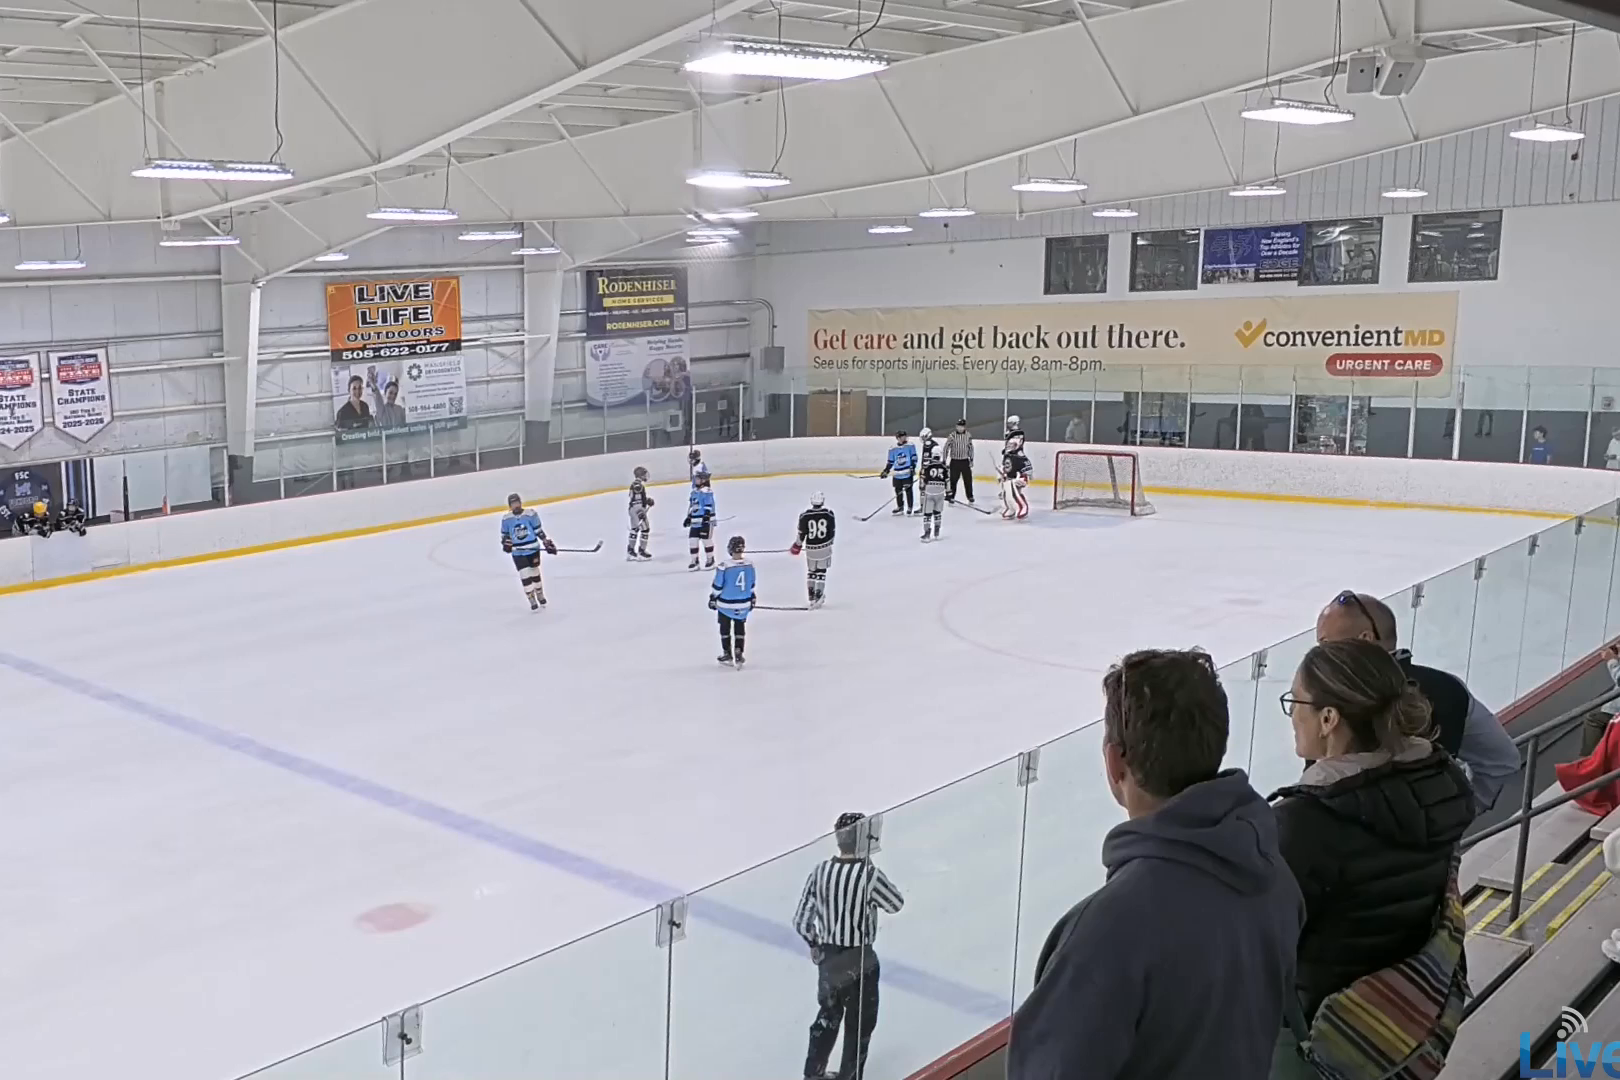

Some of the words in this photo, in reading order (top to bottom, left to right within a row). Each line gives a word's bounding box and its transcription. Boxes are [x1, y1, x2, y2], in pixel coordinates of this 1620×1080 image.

[1273, 236, 1299, 244] England's
[354, 281, 434, 304] LIVE
[358, 304, 433, 328] LIFE
[606, 319, 670, 330] RODENHISER.COM
[347, 326, 445, 342] OUTDOORS
[813, 328, 847, 350] Get
[853, 329, 897, 350] care
[902, 326, 944, 350] and
[951, 327, 986, 355] get
[992, 324, 1050, 349] back
[1056, 325, 1099, 349] out
[1106, 323, 1186, 349] there.
[1263, 323, 1445, 348] convenientMD
[342, 343, 449, 360] 508-622-0177
[813, 356, 834, 370] See
[835, 360, 849, 370] us
[851, 356, 868, 370] for
[869, 357, 908, 373] sports
[911, 356, 959, 373] injuries.
[963, 356, 998, 373] Every
[1000, 356, 1027, 373] day,
[1030, 356, 1106, 373] 8am-8pm.
[1336, 360, 1390, 371] URGENT
[1395, 360, 1432, 370] CARE
[424, 366, 461, 375] ORTHODONTICS
[67, 388, 96, 396] STATE
[0, 394, 26, 402] STATE
[57, 394, 106, 405] CHAMPIONS
[0, 401, 37, 410] AMPIONS
[0, 425, 35, 435] 24-2025
[341, 431, 367, 441] Creating
[15, 471, 30, 480] FSC
[808, 519, 828, 540] 98
[735, 570, 746, 592] 4
